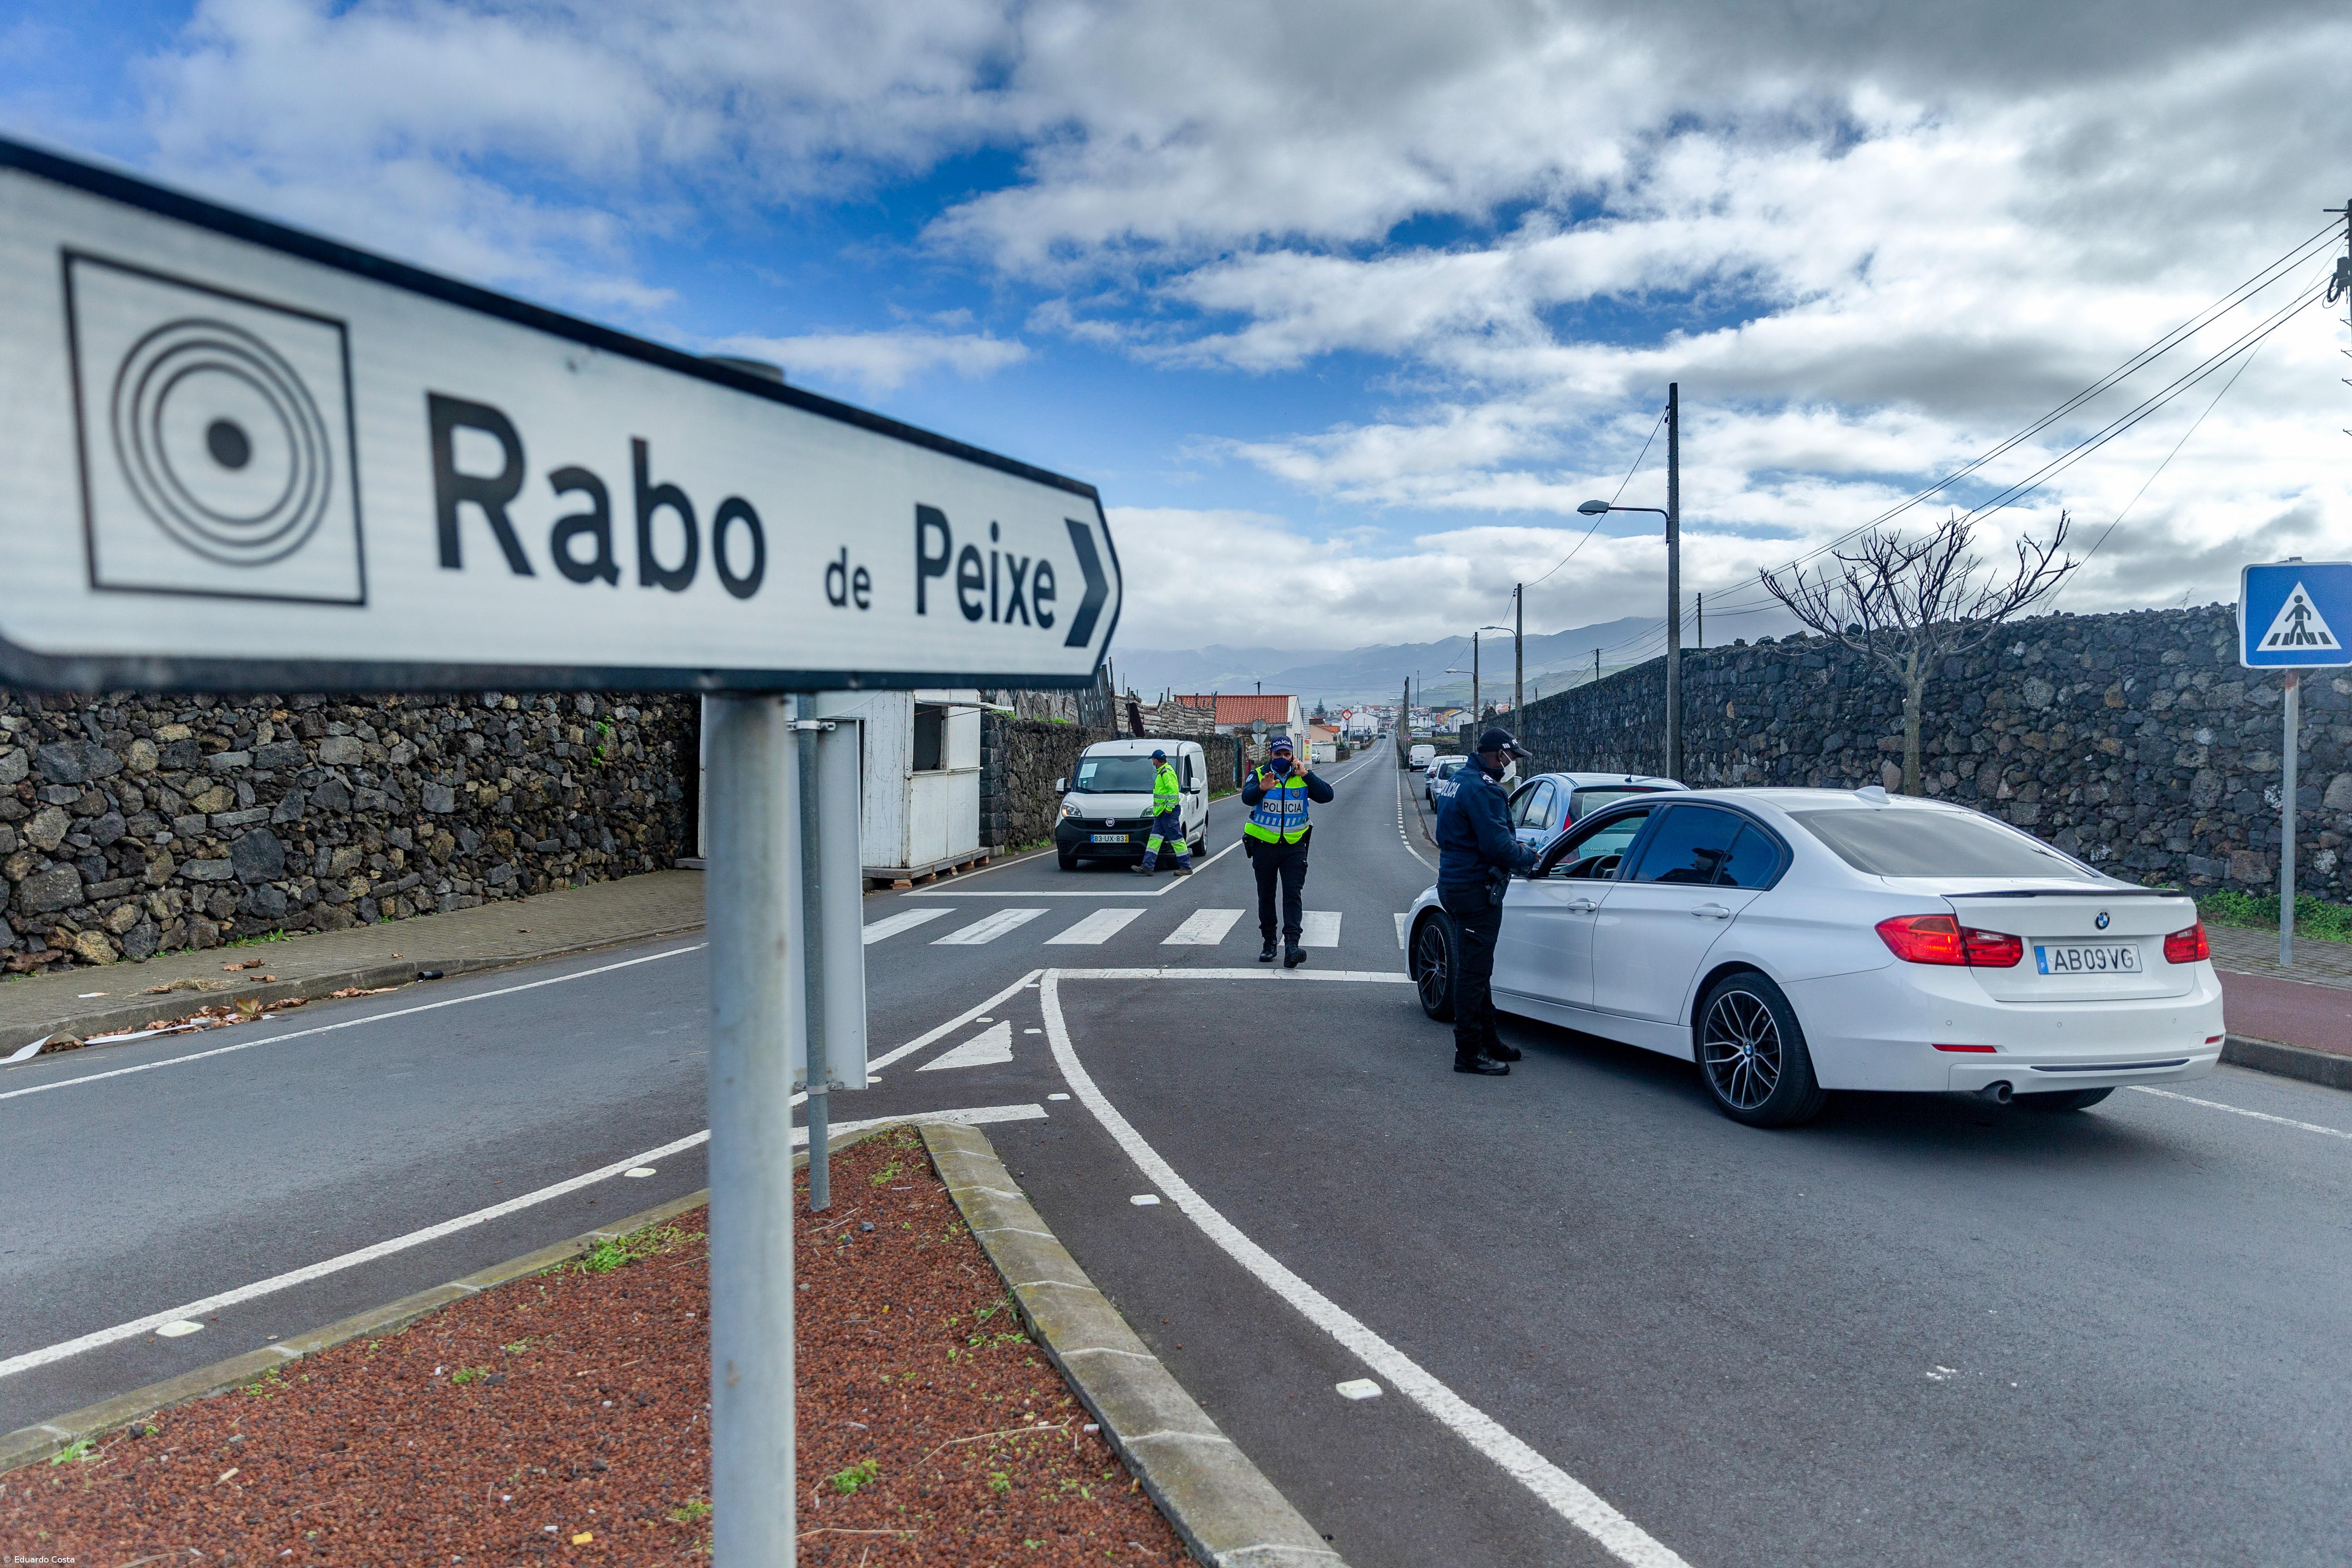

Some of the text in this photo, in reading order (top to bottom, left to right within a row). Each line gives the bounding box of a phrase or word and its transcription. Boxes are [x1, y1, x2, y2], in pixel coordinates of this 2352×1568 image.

[426, 391, 1057, 630] Rabo de Peixe
[1441, 778, 1460, 798] OLÍCIA
[1263, 801, 1302, 813] POLÍCIA
